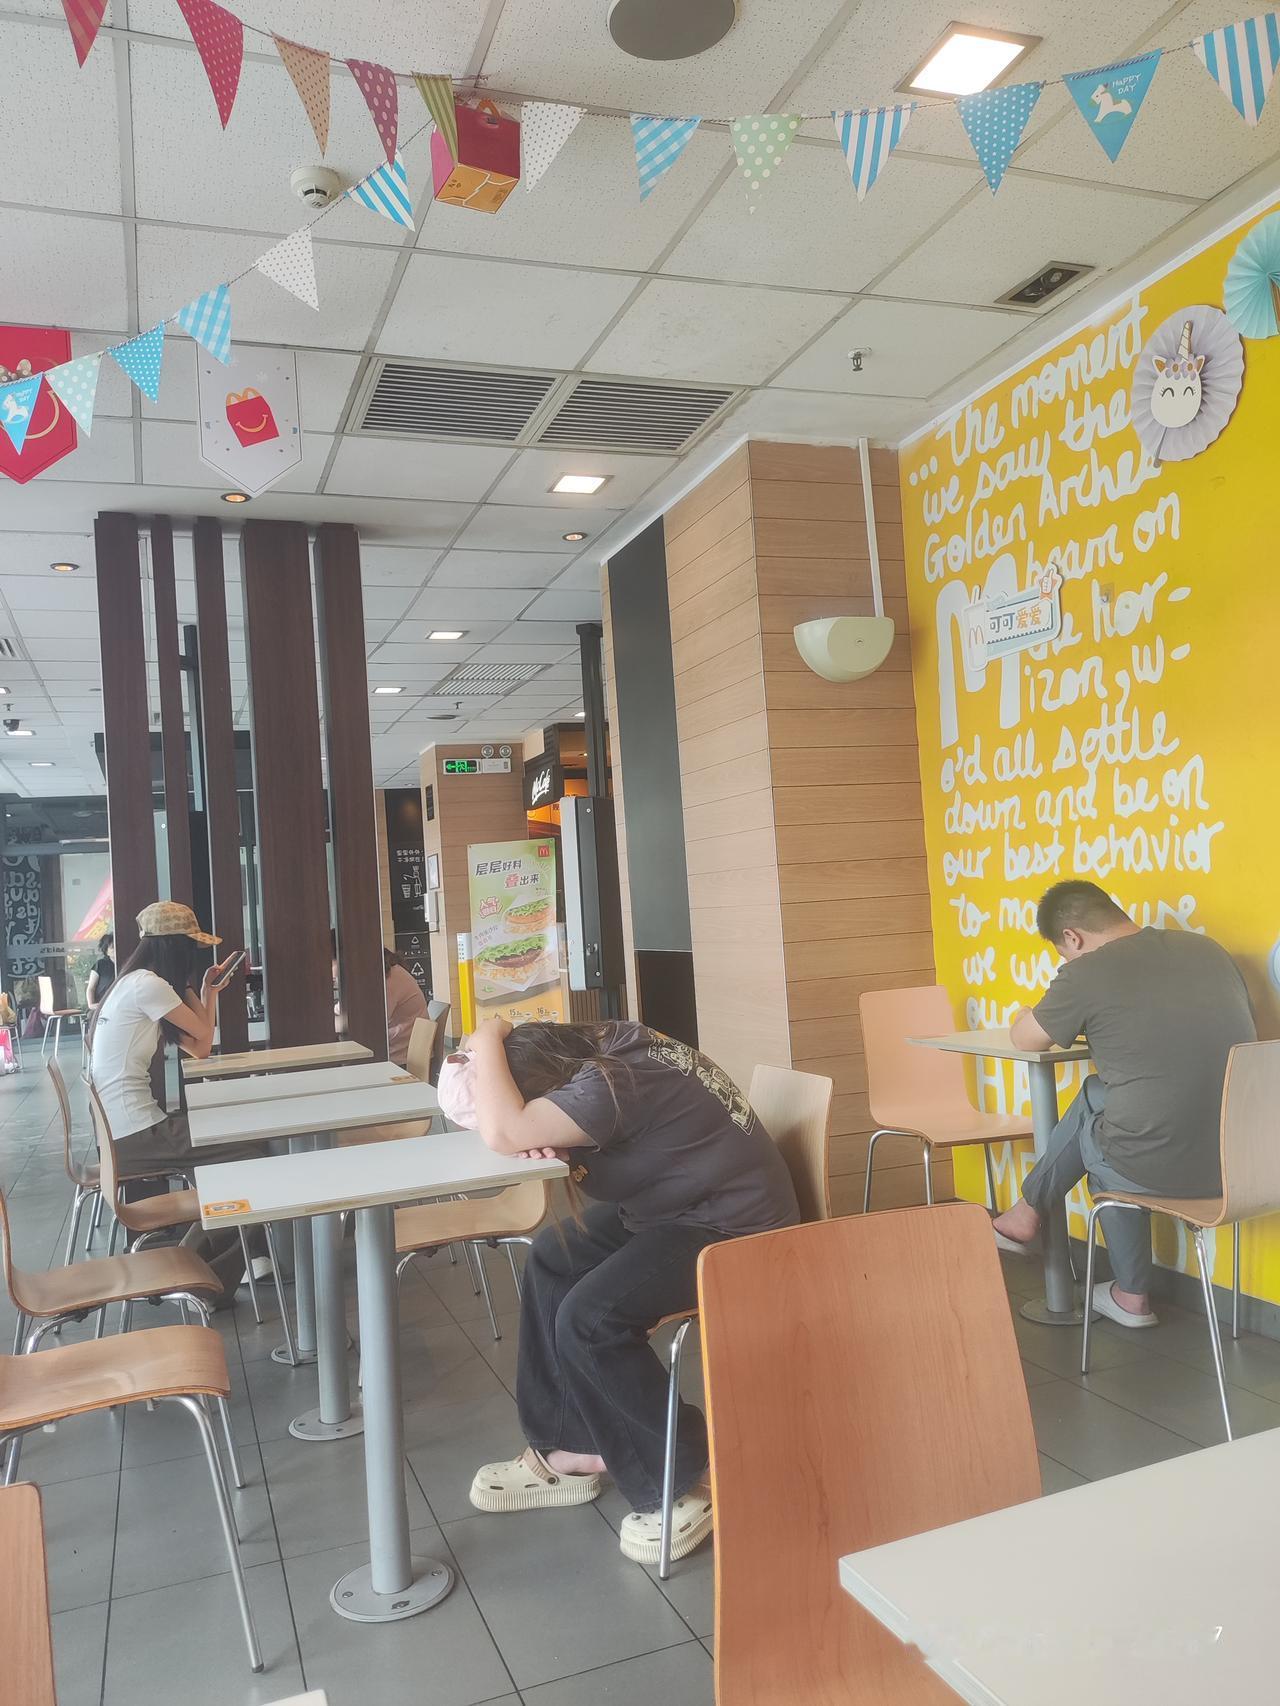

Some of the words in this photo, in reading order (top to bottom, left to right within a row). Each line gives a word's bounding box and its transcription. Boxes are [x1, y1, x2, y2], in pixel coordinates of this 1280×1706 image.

[1118, 83, 1137, 95] DAY
[1011, 293, 1148, 429] moment
[923, 475, 965, 526] we
[974, 430, 1051, 499] saw
[1059, 390, 1132, 452] the
[924, 502, 1026, 583] Golden
[1133, 492, 1180, 552] on
[989, 603, 1042, 634] 可可爱爱
[993, 727, 1044, 782] all
[1052, 703, 1180, 773] settle
[944, 791, 1026, 834] down
[1035, 770, 1097, 828] and
[1114, 768, 1159, 818] be
[1162, 754, 1209, 810] on
[475, 859, 522, 876] 层层好料
[943, 847, 991, 886] our
[1004, 830, 1065, 882] best
[1073, 814, 1225, 878] behavior
[949, 892, 991, 937] to
[963, 946, 996, 986] we
[967, 997, 1020, 1030] our
